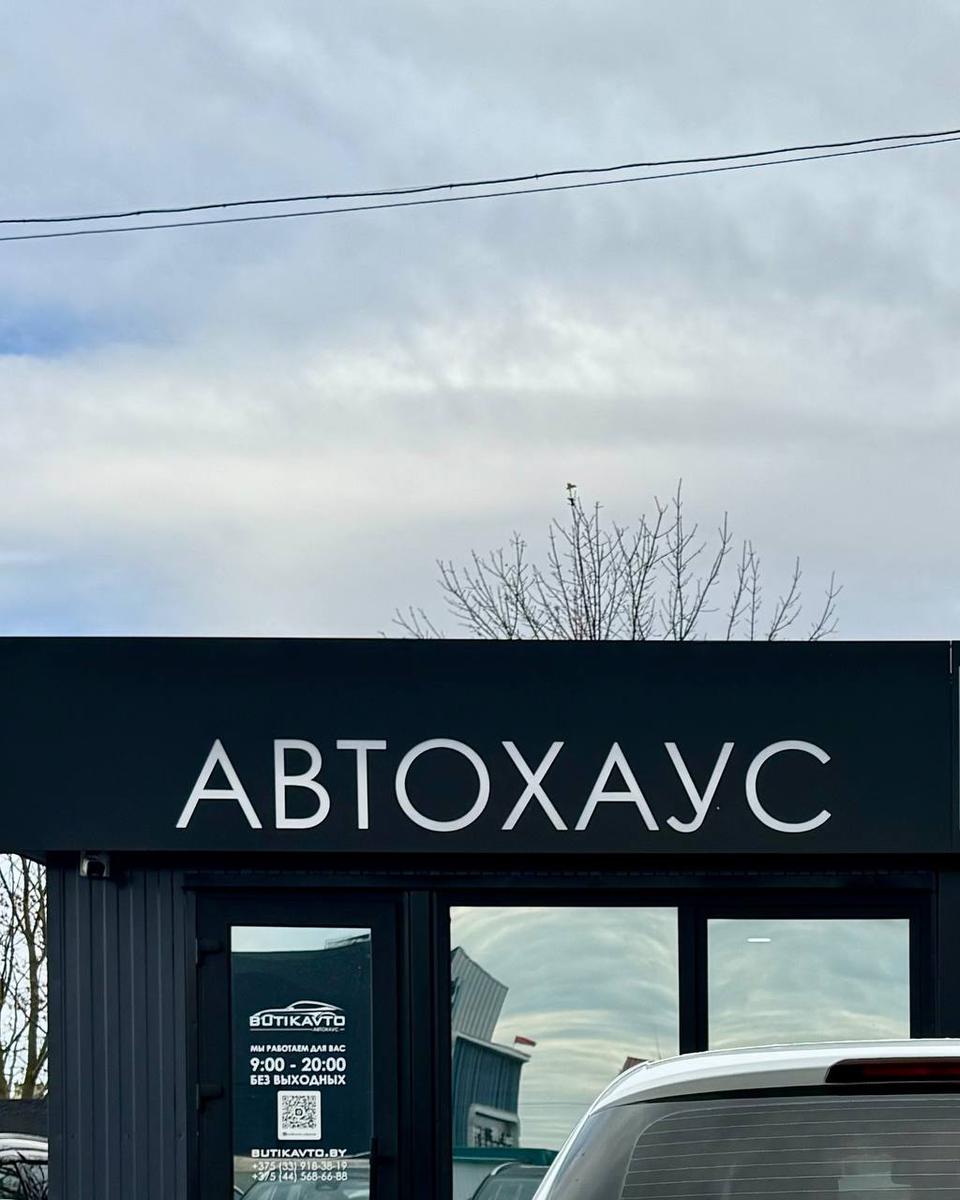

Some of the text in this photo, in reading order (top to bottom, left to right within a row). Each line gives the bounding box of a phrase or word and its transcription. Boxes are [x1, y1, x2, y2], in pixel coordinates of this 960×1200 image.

[175, 738, 832, 834] АВТОХАУС
[250, 1015, 345, 1026] BUTIKAVTO
[310, 1045, 327, 1053] ДЛЯ
[250, 1057, 285, 1072] 9:00
[301, 1057, 346, 1071] 20:00
[250, 1075, 346, 1086] БЕЗ ВЫХОДНЫХ
[251, 1149, 347, 1158] BUTIKAVTO.BY
[252, 1161, 347, 1171] +375 (33) 918-38-19
[252, 1172, 347, 1182] +375 (44) 568-66-88
